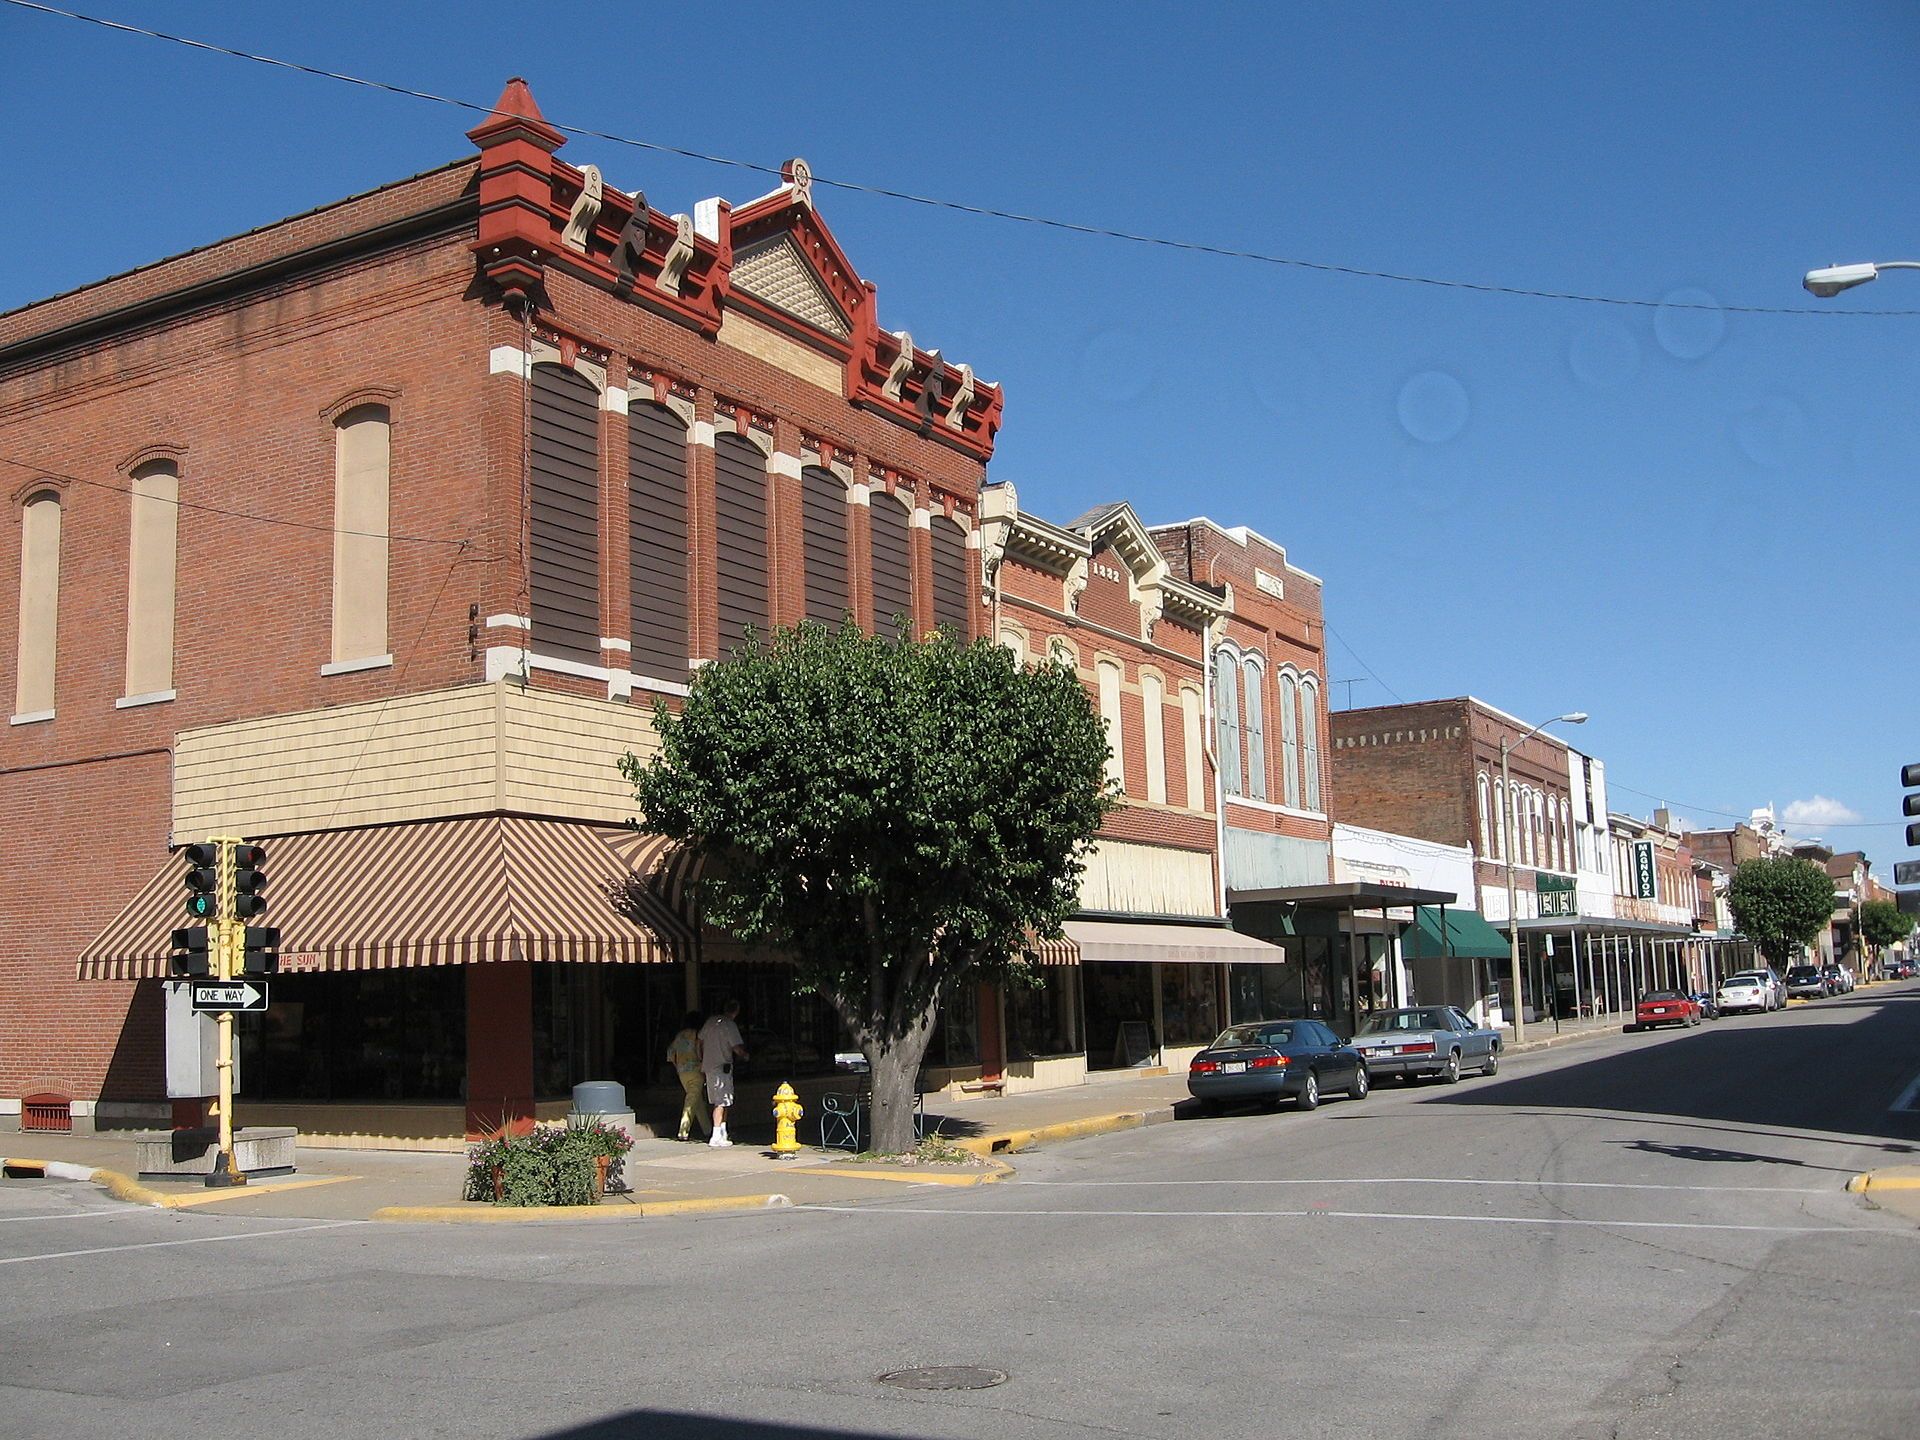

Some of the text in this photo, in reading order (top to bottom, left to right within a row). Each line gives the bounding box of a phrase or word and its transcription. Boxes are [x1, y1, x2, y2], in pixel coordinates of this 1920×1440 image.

[1638, 843, 1650, 897] MAGNAVOX
[280, 954, 316, 966] HE SUN
[200, 989, 245, 1001] ONE WAY
